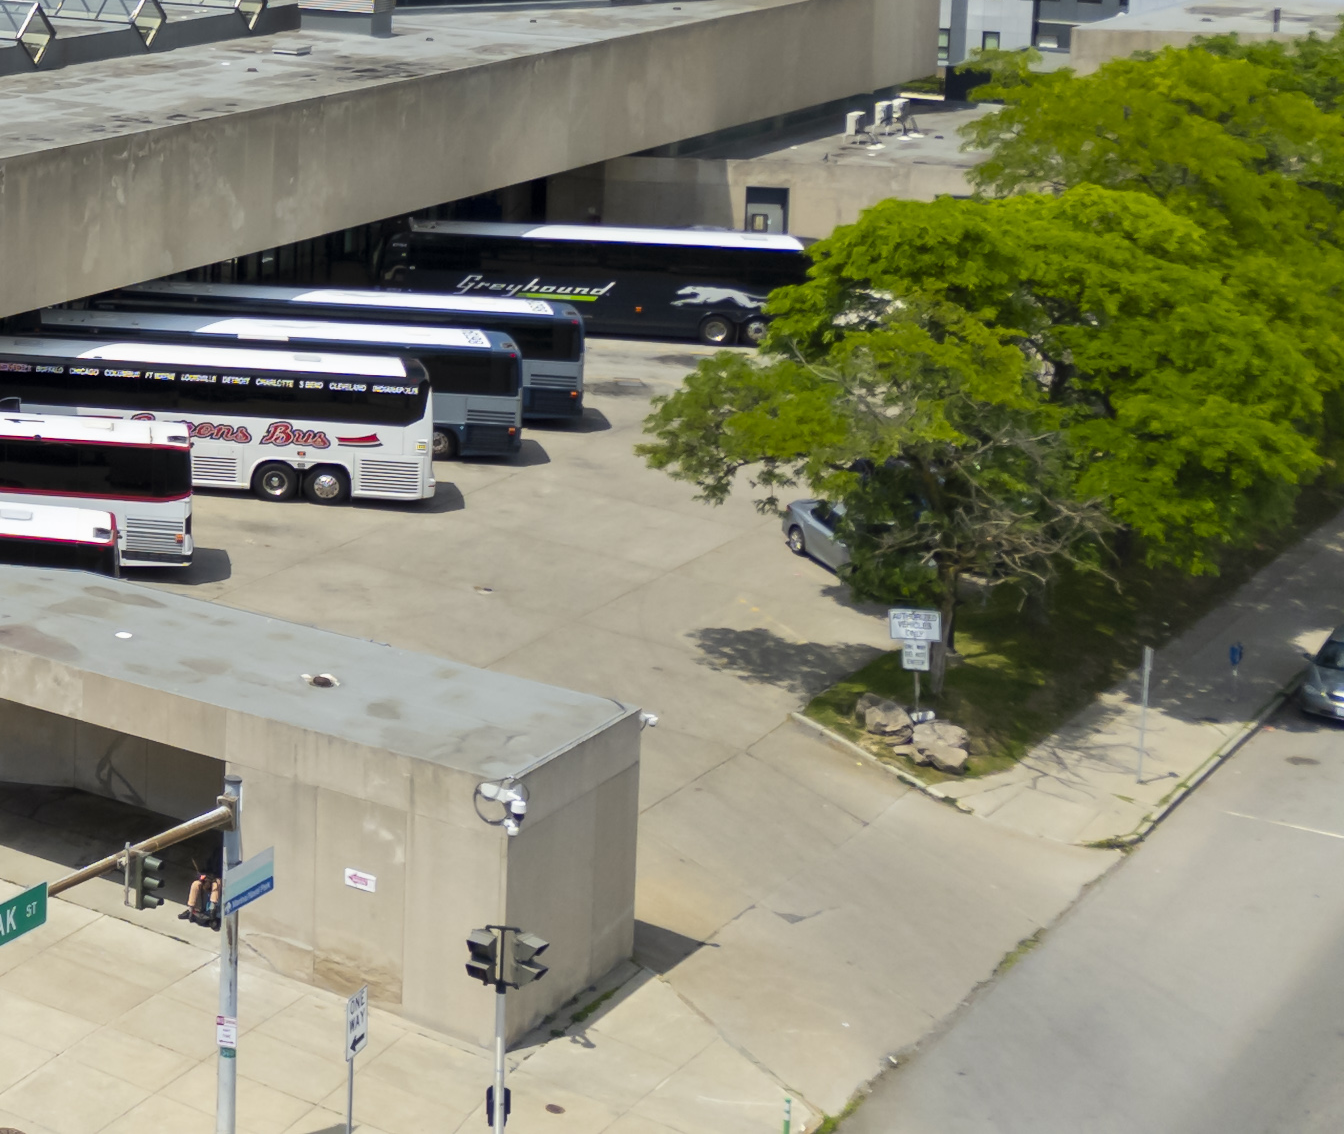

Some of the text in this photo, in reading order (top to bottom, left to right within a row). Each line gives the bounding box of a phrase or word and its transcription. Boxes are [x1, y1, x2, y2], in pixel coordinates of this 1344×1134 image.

[453, 274, 616, 297] Greyhound
[69, 367, 99, 376] CHICAGO
[222, 376, 250, 385] DETROIT
[256, 378, 294, 388] CHARLOTTE
[329, 382, 367, 392] CLEVELAND
[372, 385, 418, 395] INDIANAPOLIS
[259, 421, 331, 449] Bus
[25, 901, 37, 918] ST
[350, 989, 365, 1015] ONE
[349, 1008, 365, 1034] WAY
